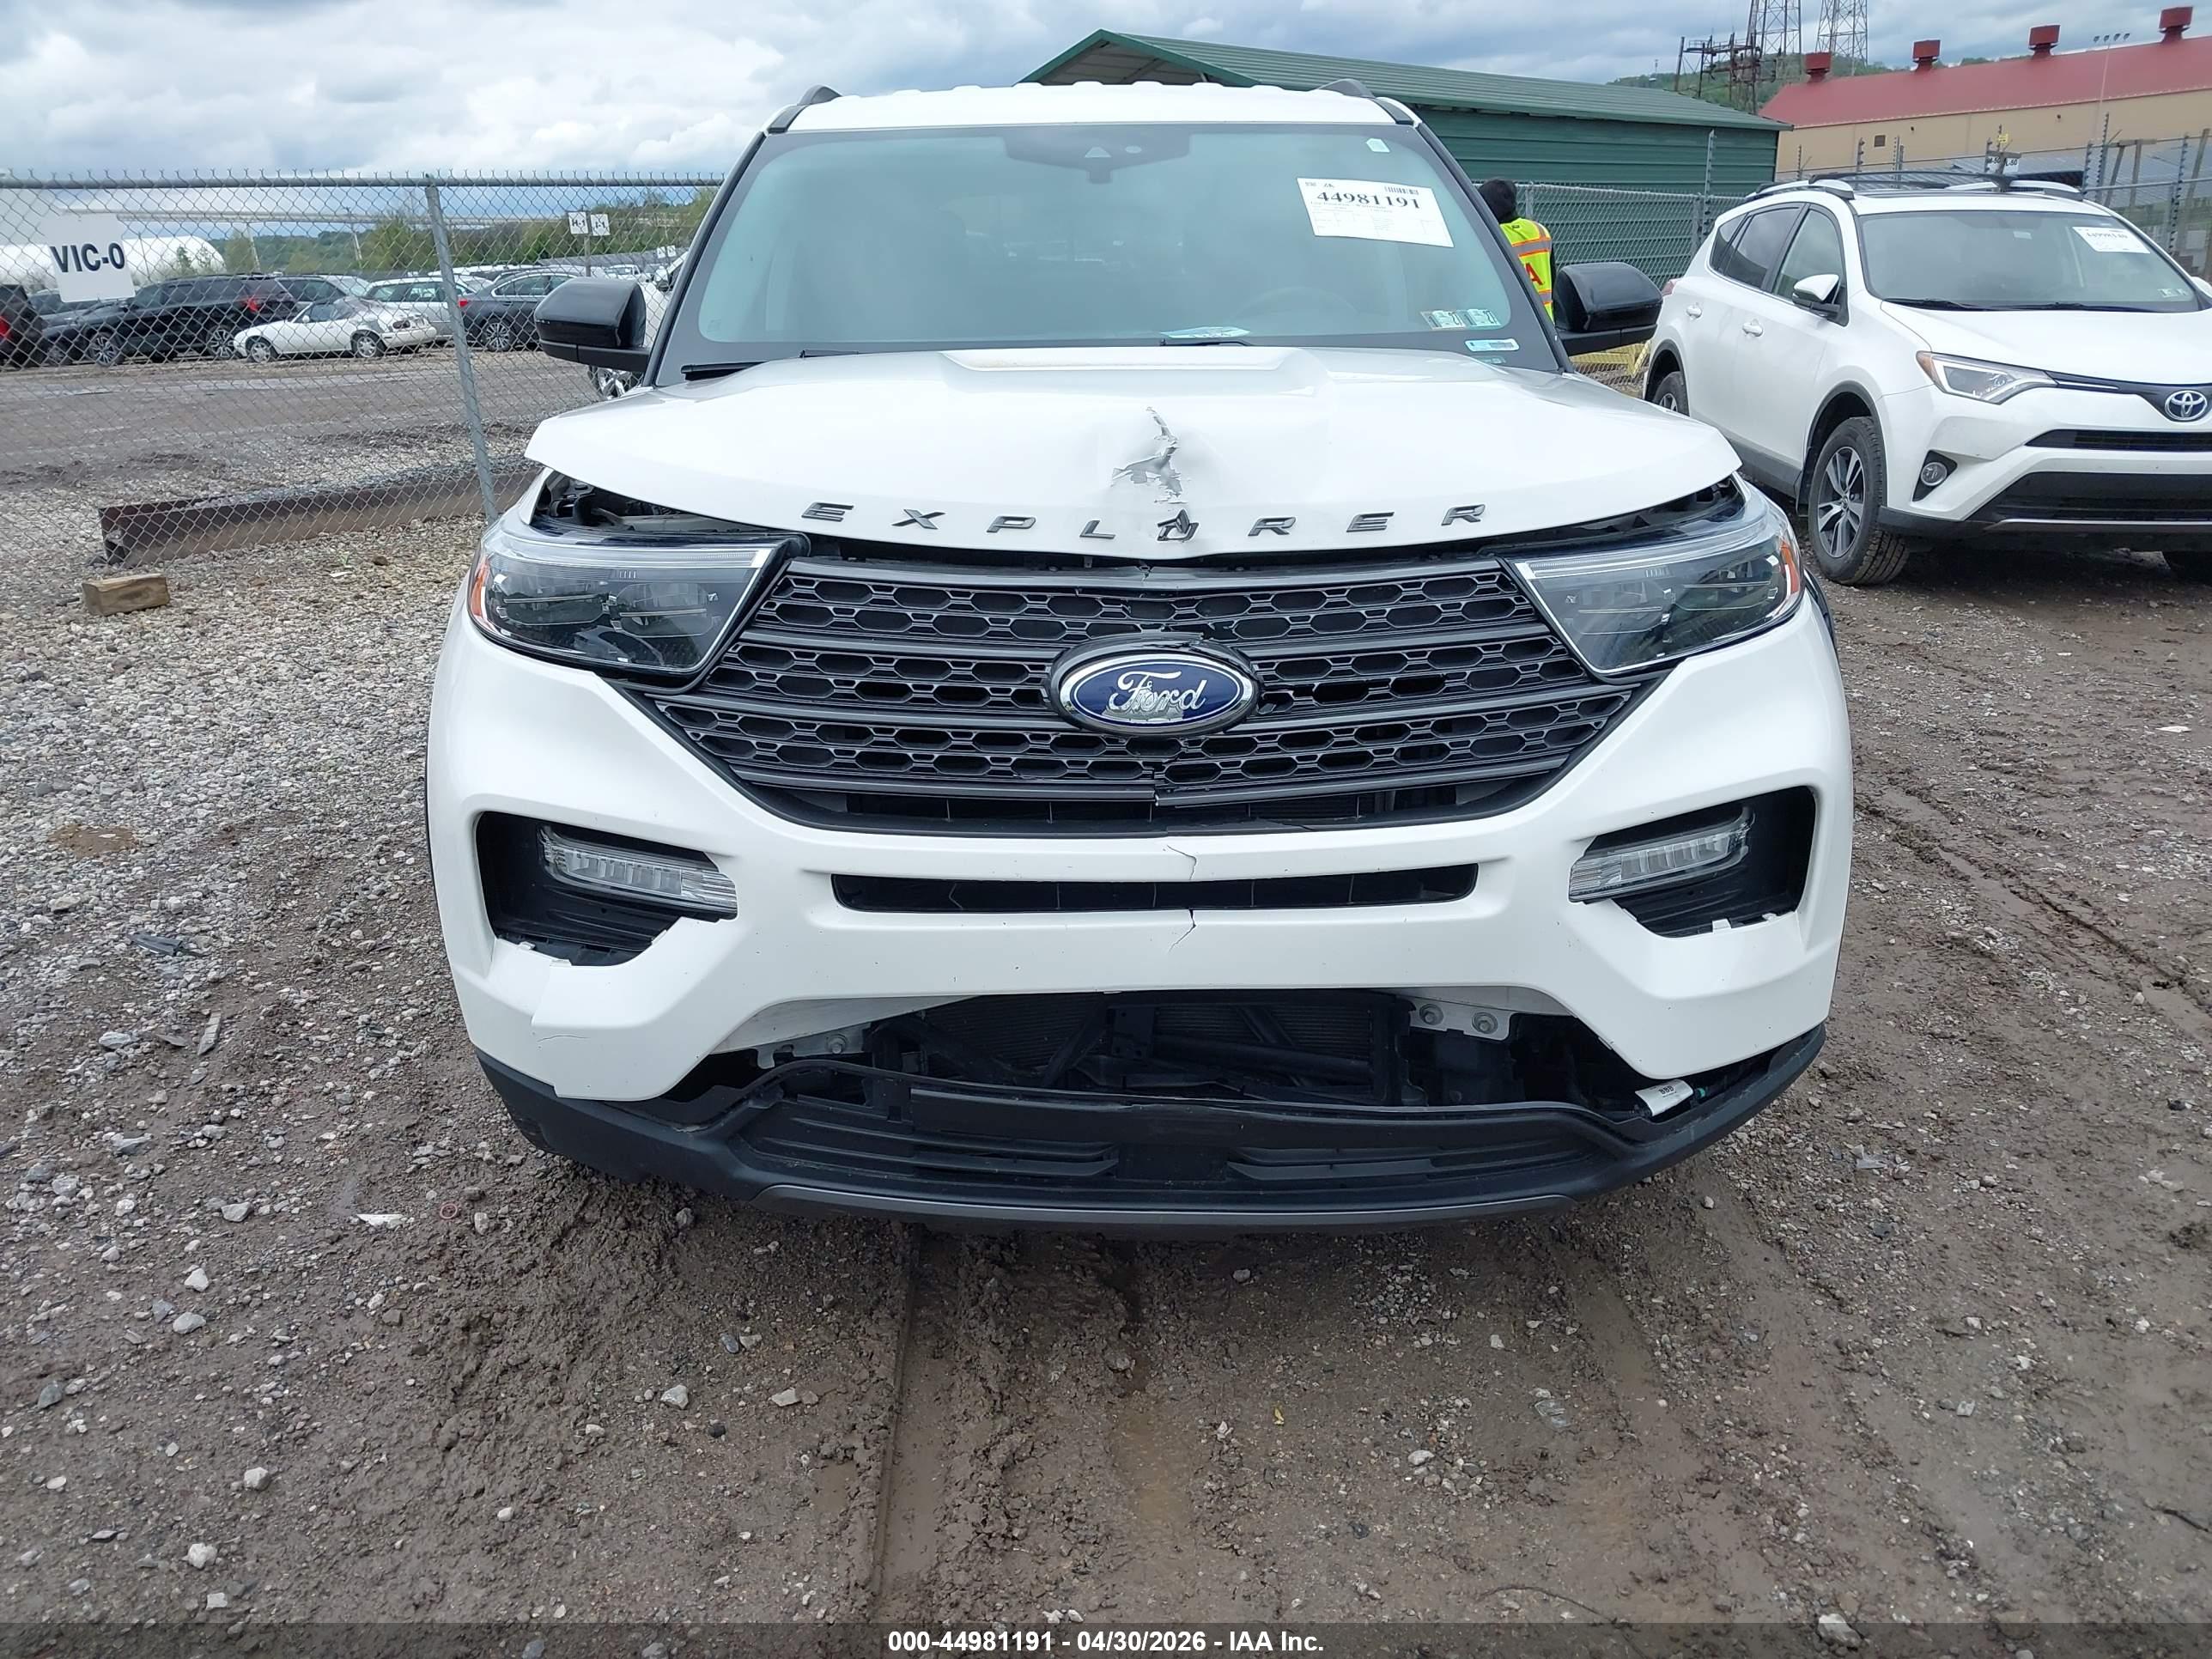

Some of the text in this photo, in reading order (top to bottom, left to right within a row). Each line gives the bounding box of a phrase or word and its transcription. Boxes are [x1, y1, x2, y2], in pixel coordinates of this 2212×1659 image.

[1316, 191, 1421, 210] 44981191
[50, 242, 126, 273] VIC-0
[801, 501, 1488, 542] EXPLORER
[1109, 671, 1209, 712] Ford
